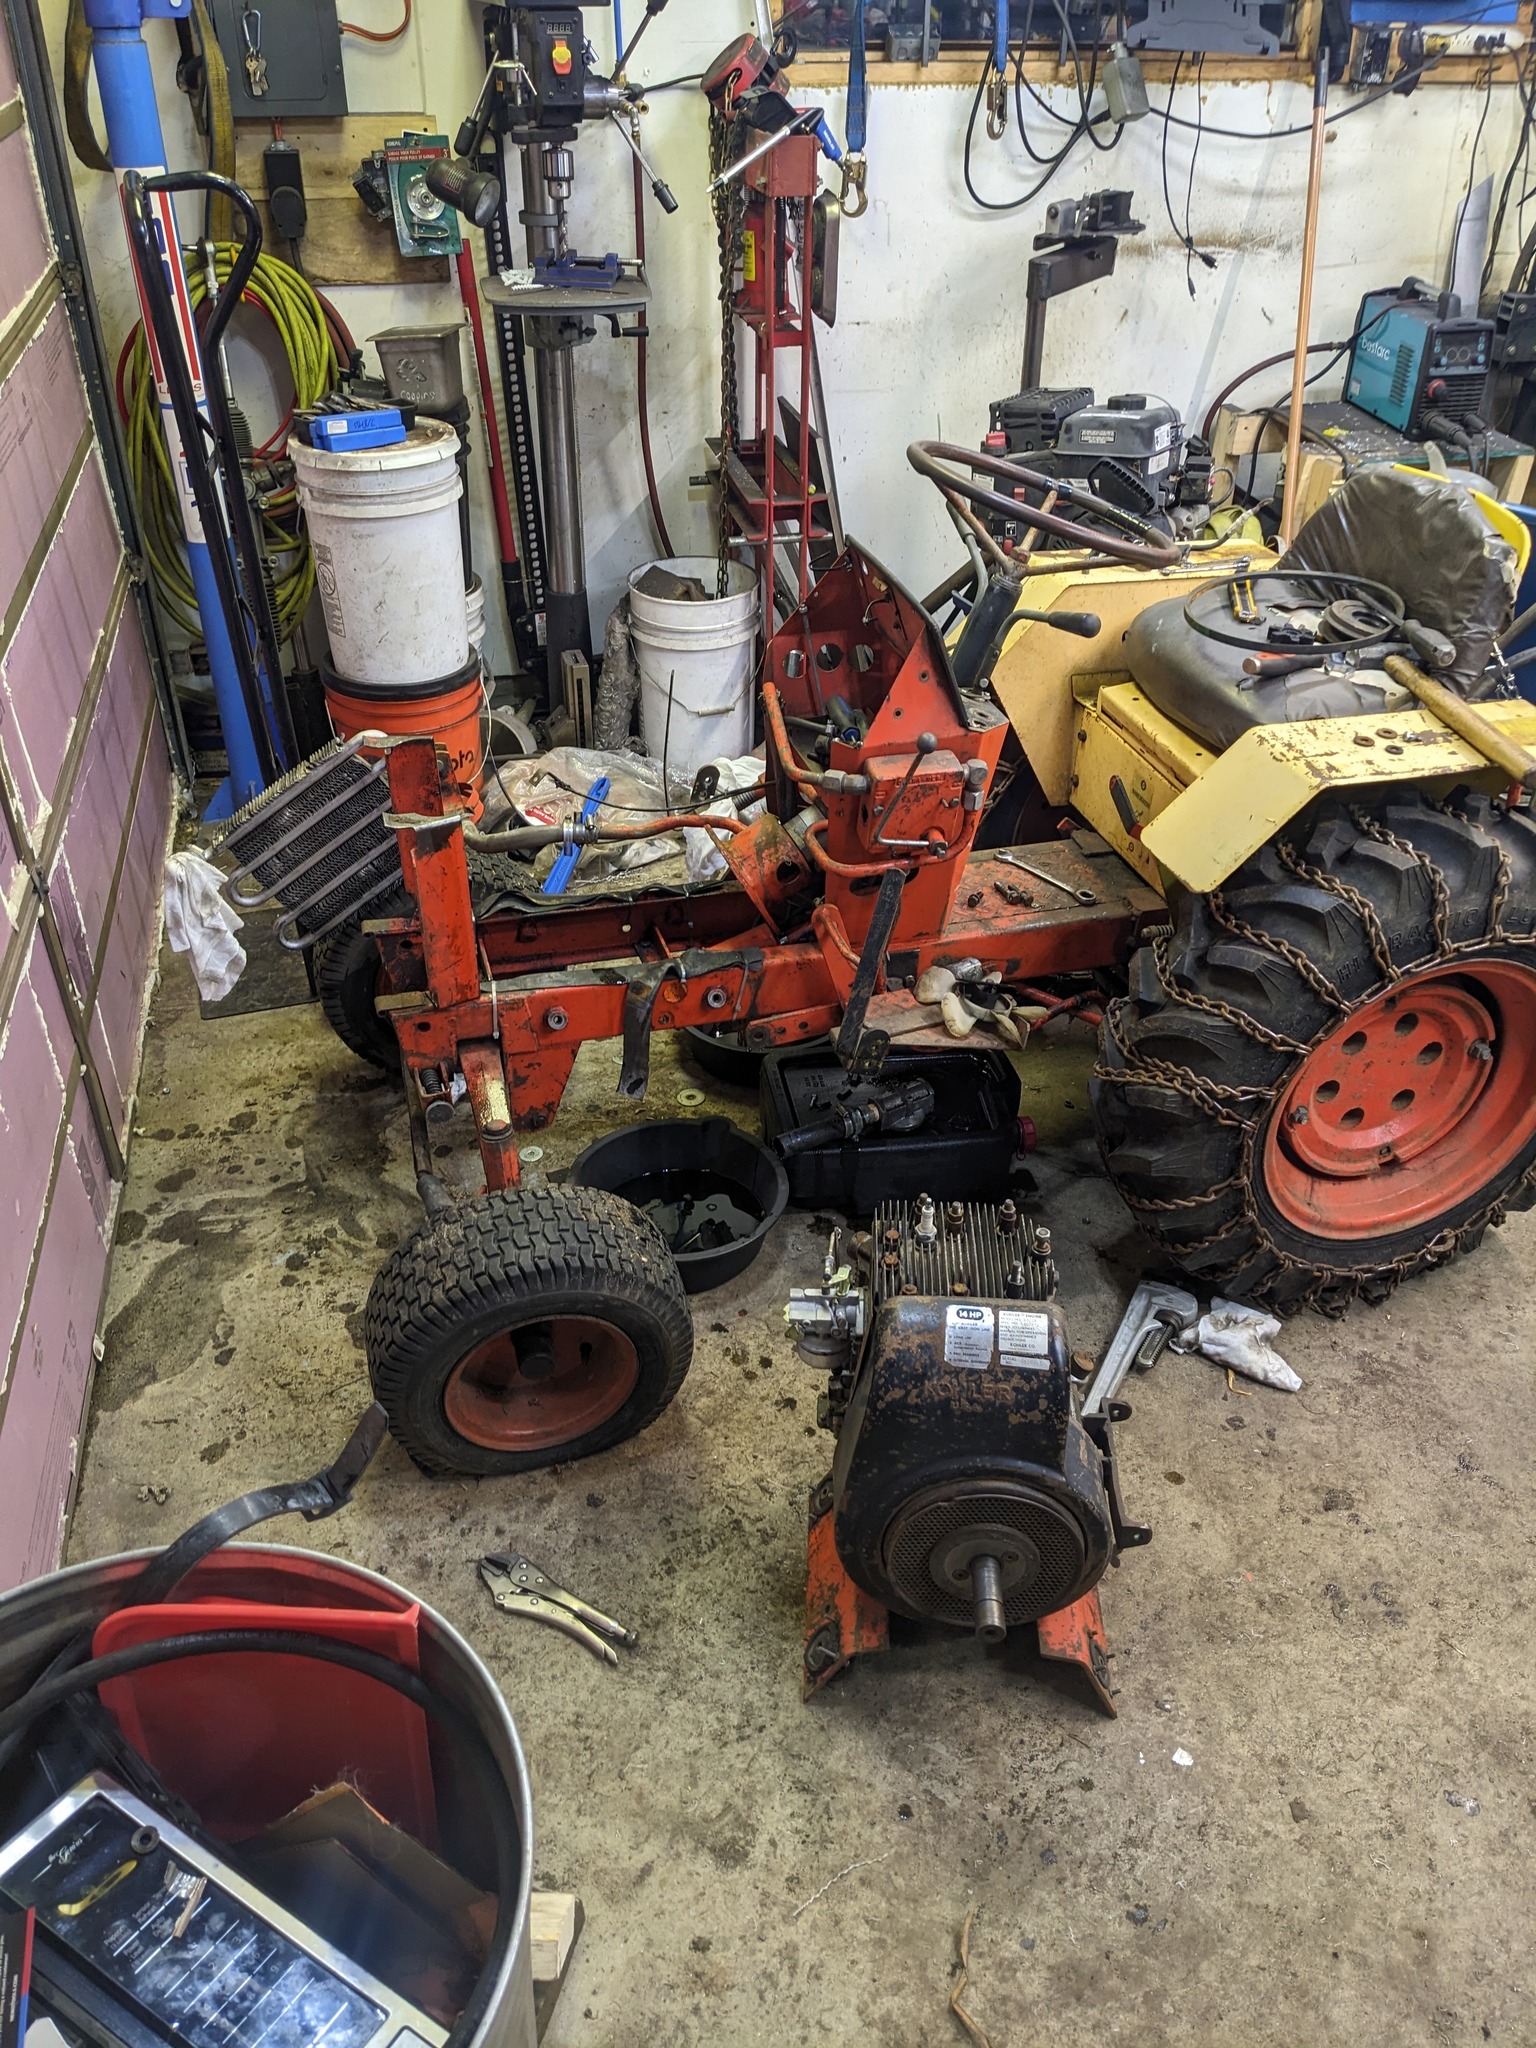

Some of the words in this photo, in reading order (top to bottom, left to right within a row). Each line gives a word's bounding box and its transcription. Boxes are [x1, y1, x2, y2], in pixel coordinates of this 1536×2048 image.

[958, 1310, 969, 1318] 14
[969, 1310, 982, 1319] HP
[923, 1379, 1012, 1402] KOHLER
